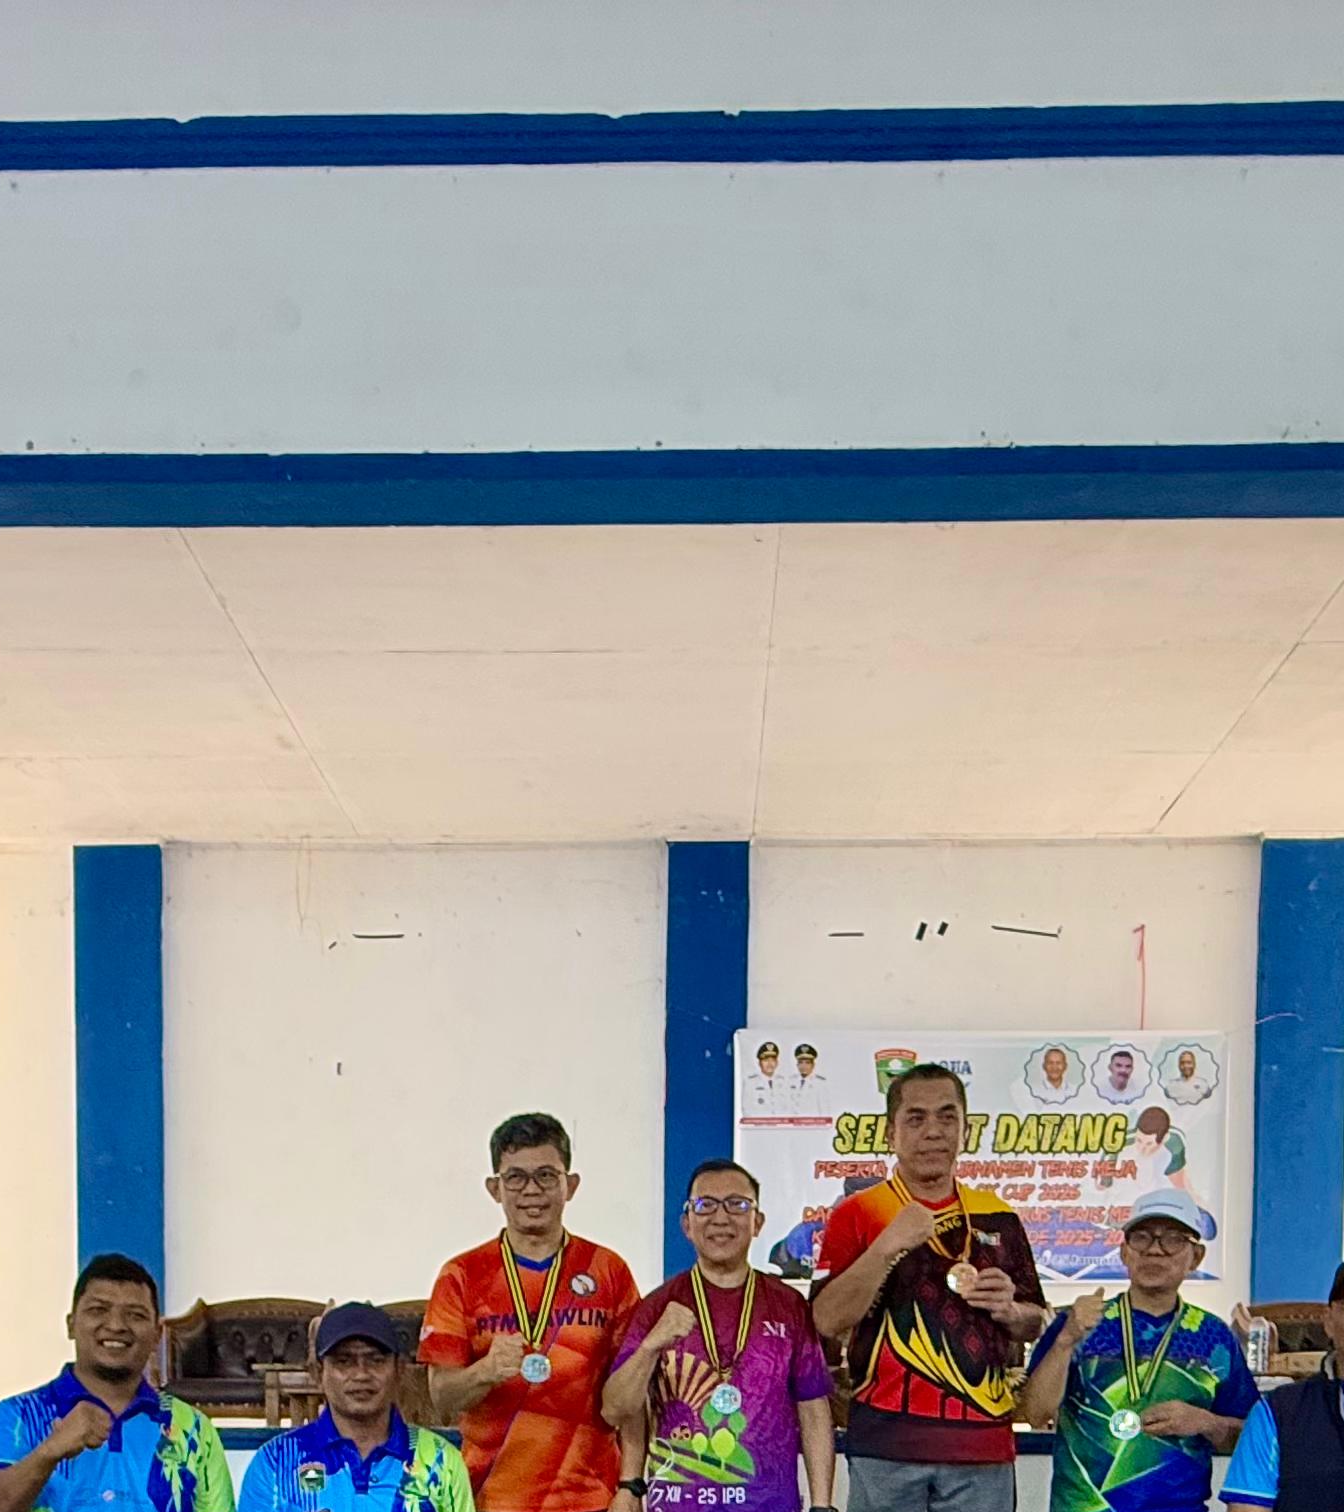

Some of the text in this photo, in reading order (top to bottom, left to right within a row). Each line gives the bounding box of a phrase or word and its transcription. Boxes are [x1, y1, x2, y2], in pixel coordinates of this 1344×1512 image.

[993, 1113, 1128, 1156] DATANG
[815, 1160, 888, 1179] PESERTA
[1038, 1160, 1089, 1179] TENIS
[1091, 1159, 1138, 1179] MEJA
[1002, 1183, 1036, 1201] CUP
[1056, 1206, 1105, 1224] TENIS
[1108, 1204, 1132, 1224] ME
[698, 1487, 717, 1504] 25
[722, 1487, 746, 1504] IPB
